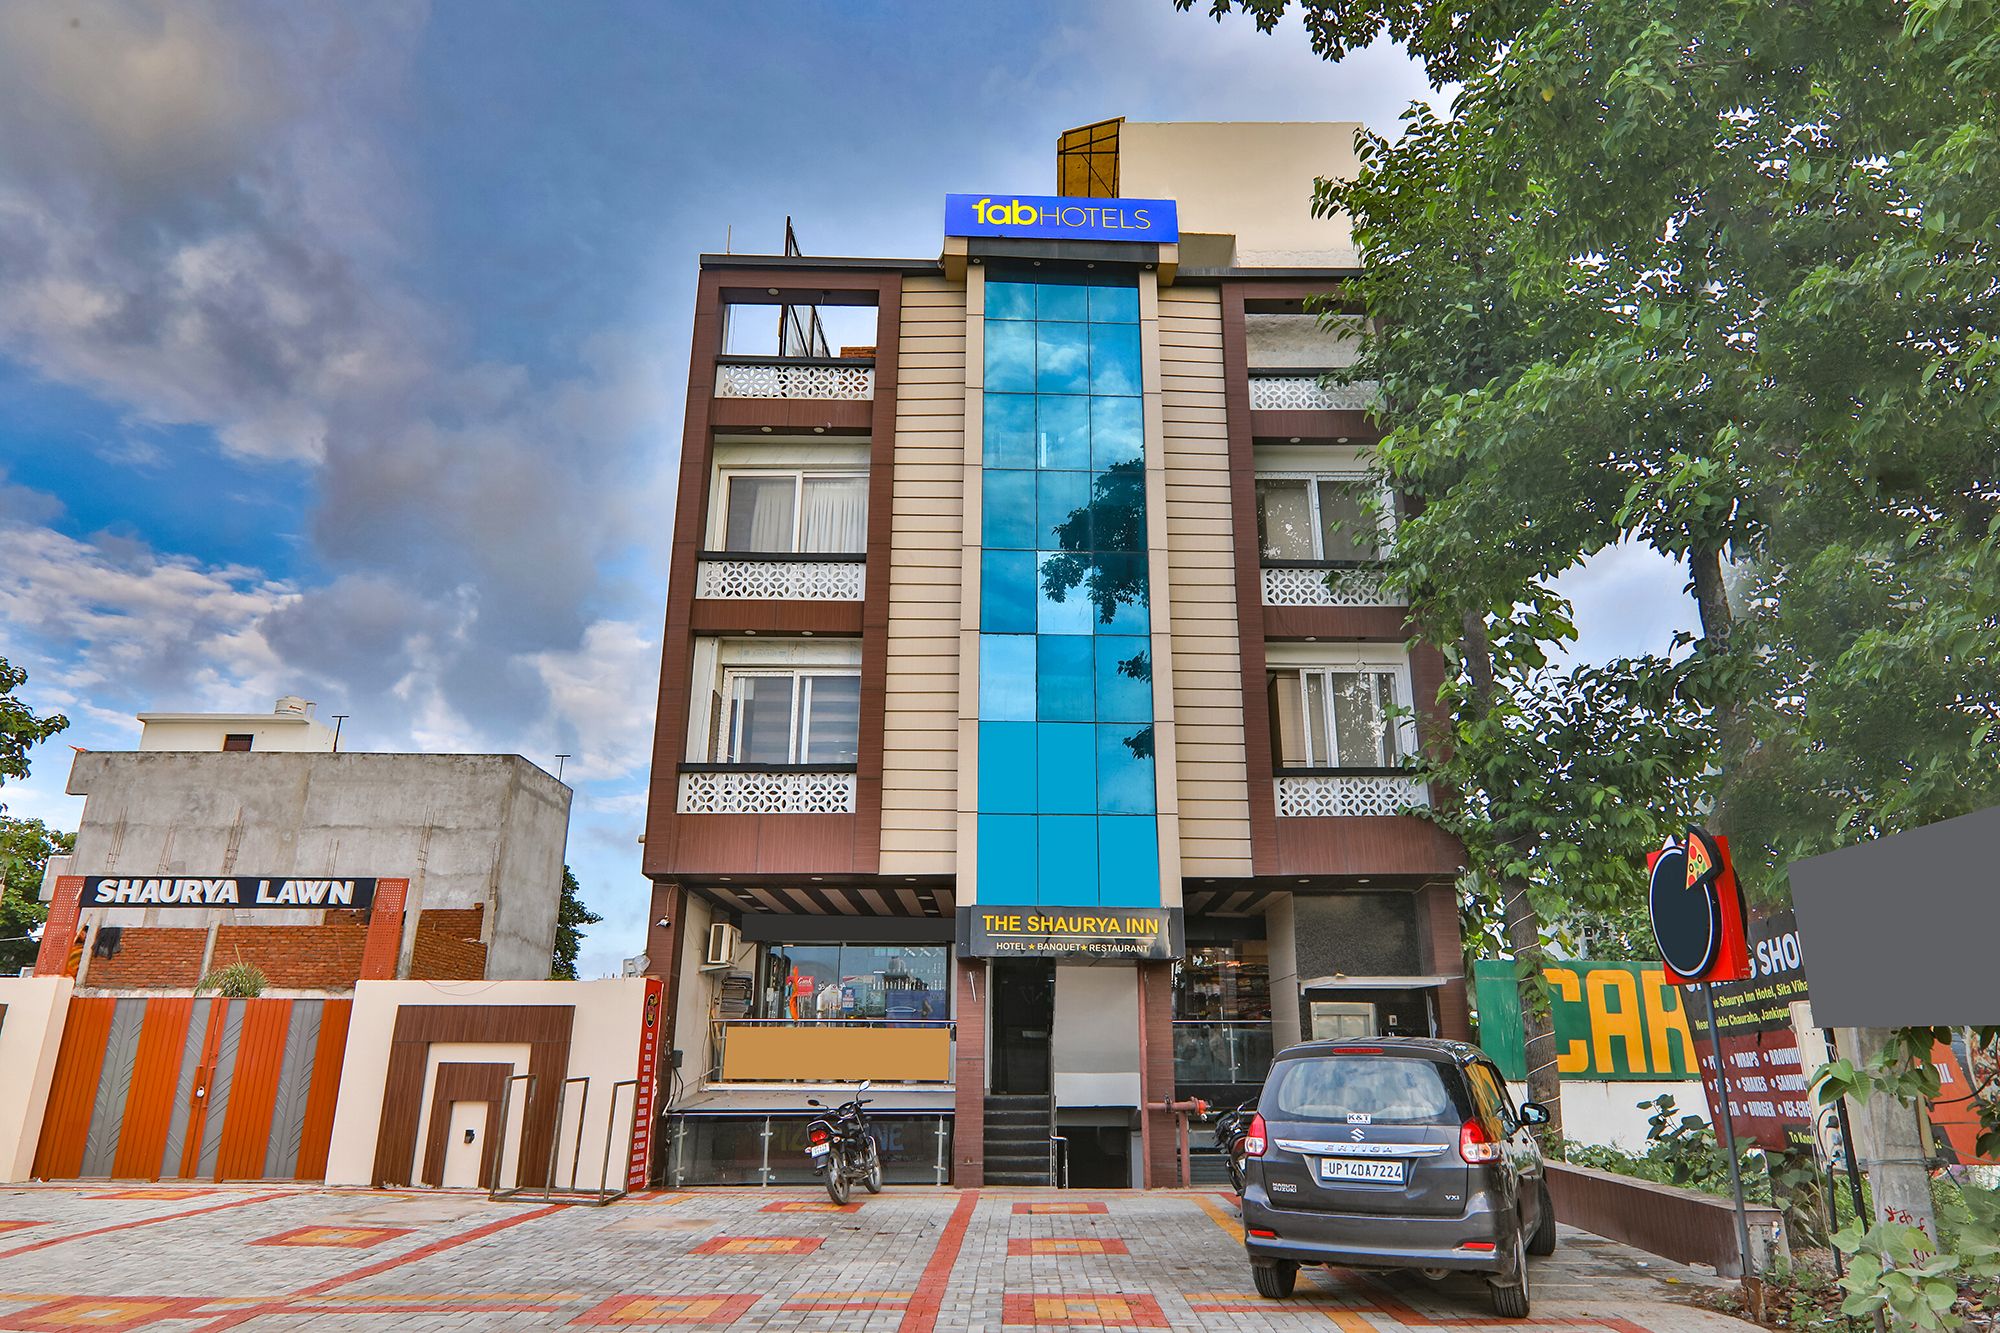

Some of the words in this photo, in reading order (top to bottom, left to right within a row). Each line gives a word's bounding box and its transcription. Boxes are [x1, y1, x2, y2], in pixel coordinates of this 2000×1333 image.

[94, 879, 239, 904] SHAURYA
[256, 880, 354, 905] LAWN
[982, 915, 1021, 931] THE
[1027, 915, 1121, 933] SHAURYA
[1126, 918, 1159, 934] INN
[996, 942, 1026, 951] HOTEL
[1037, 942, 1081, 952] BANQUET
[1089, 943, 1149, 953] RESTAURANT
[1757, 931, 1804, 976] SHO
[1719, 995, 1745, 1007] Shaurya
[1744, 991, 1756, 1003] Inn
[1755, 986, 1777, 1000] Hotel,
[1776, 982, 1792, 996] Sita
[1695, 1019, 1709, 1031] Near
[1728, 1010, 1761, 1026] Chauraha,
[1734, 1051, 1760, 1068] WRAPS
[1741, 1076, 1768, 1092] SHAKES
[1747, 1101, 1777, 1117] BURGER
[1788, 1131, 1799, 1144] To
[1324, 1144, 1392, 1153] ERTIGA
[1328, 1162, 1401, 1178] UP14DA7224
